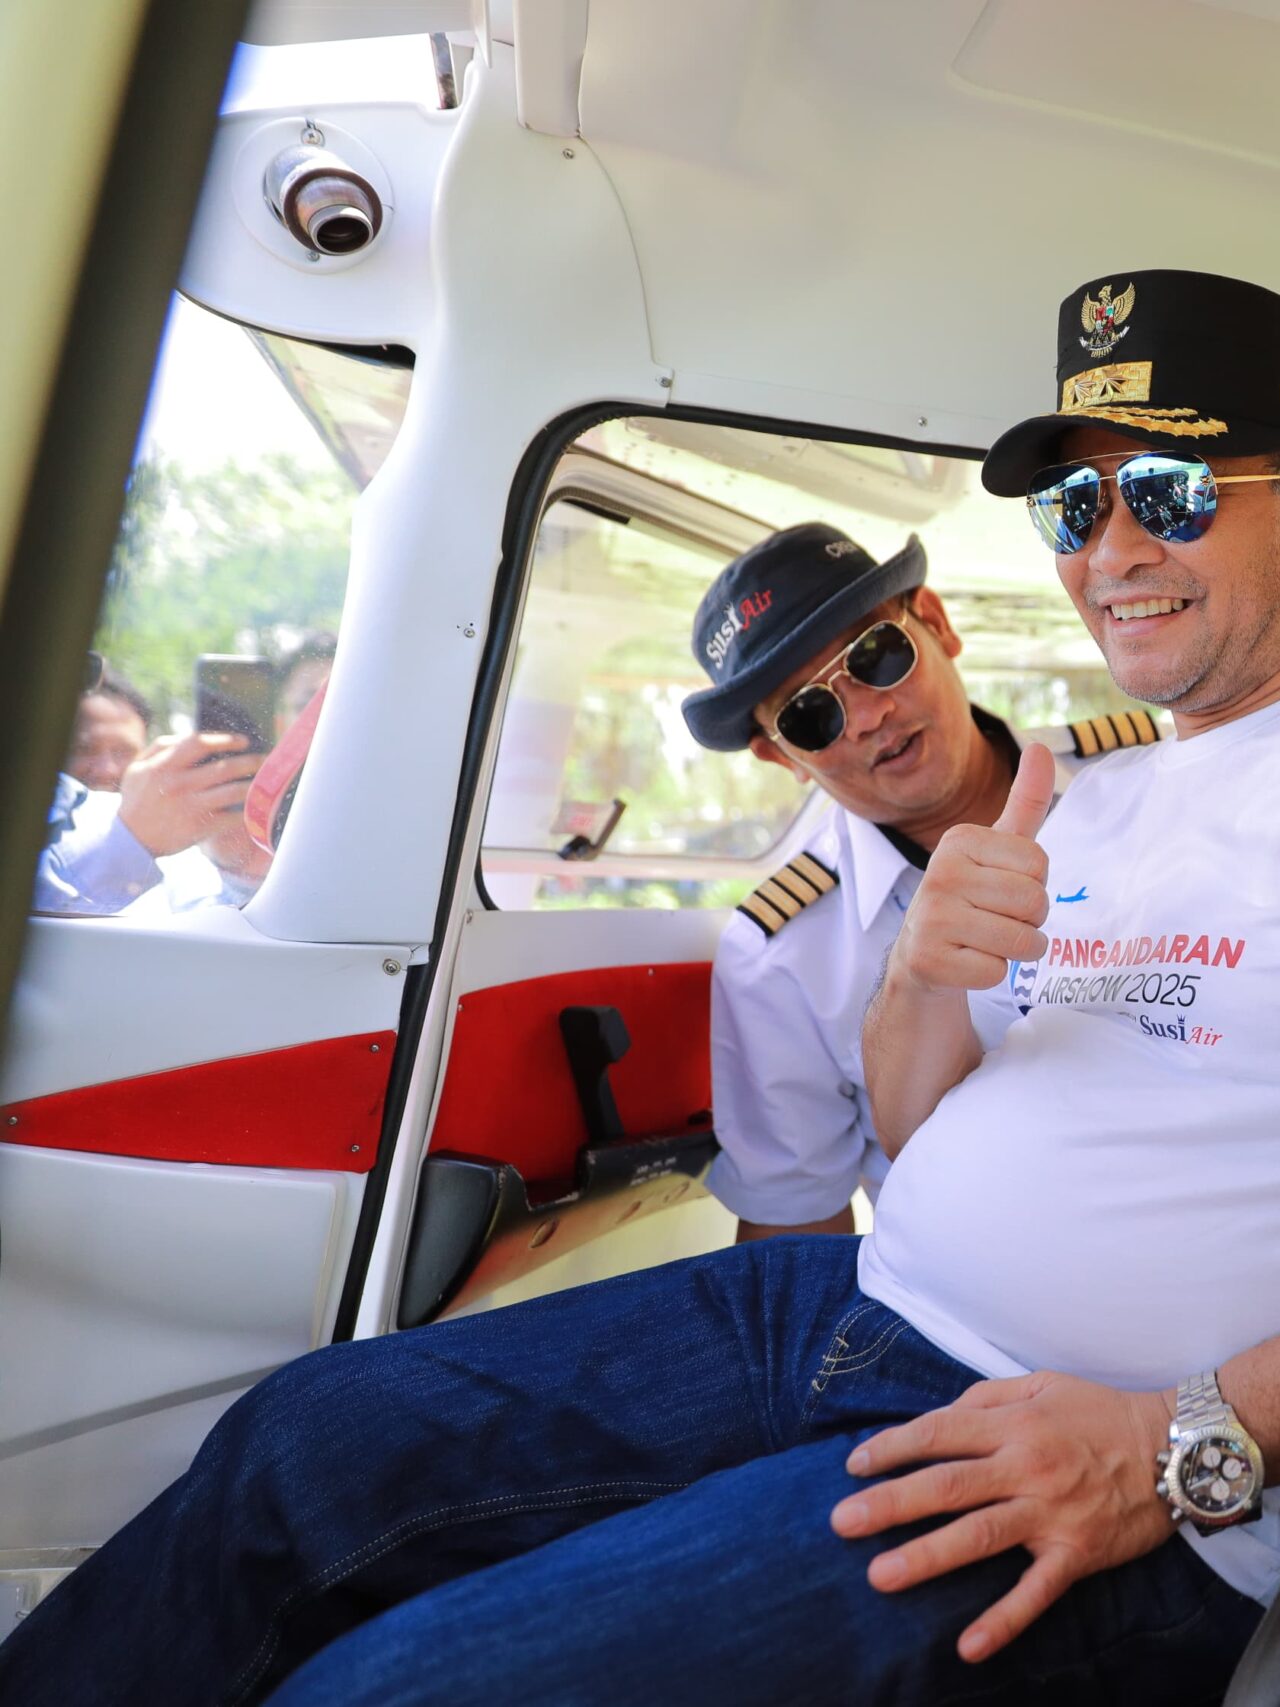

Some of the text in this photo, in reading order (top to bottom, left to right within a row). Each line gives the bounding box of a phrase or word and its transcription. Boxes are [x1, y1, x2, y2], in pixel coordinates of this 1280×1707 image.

[739, 590, 772, 630] Air
[1048, 934, 1246, 969] PANGANDARAN
[1038, 973, 1201, 1007] AIRSHOW 2025
[1139, 1014, 1187, 1042] Susi
[1184, 1026, 1223, 1046] Air
